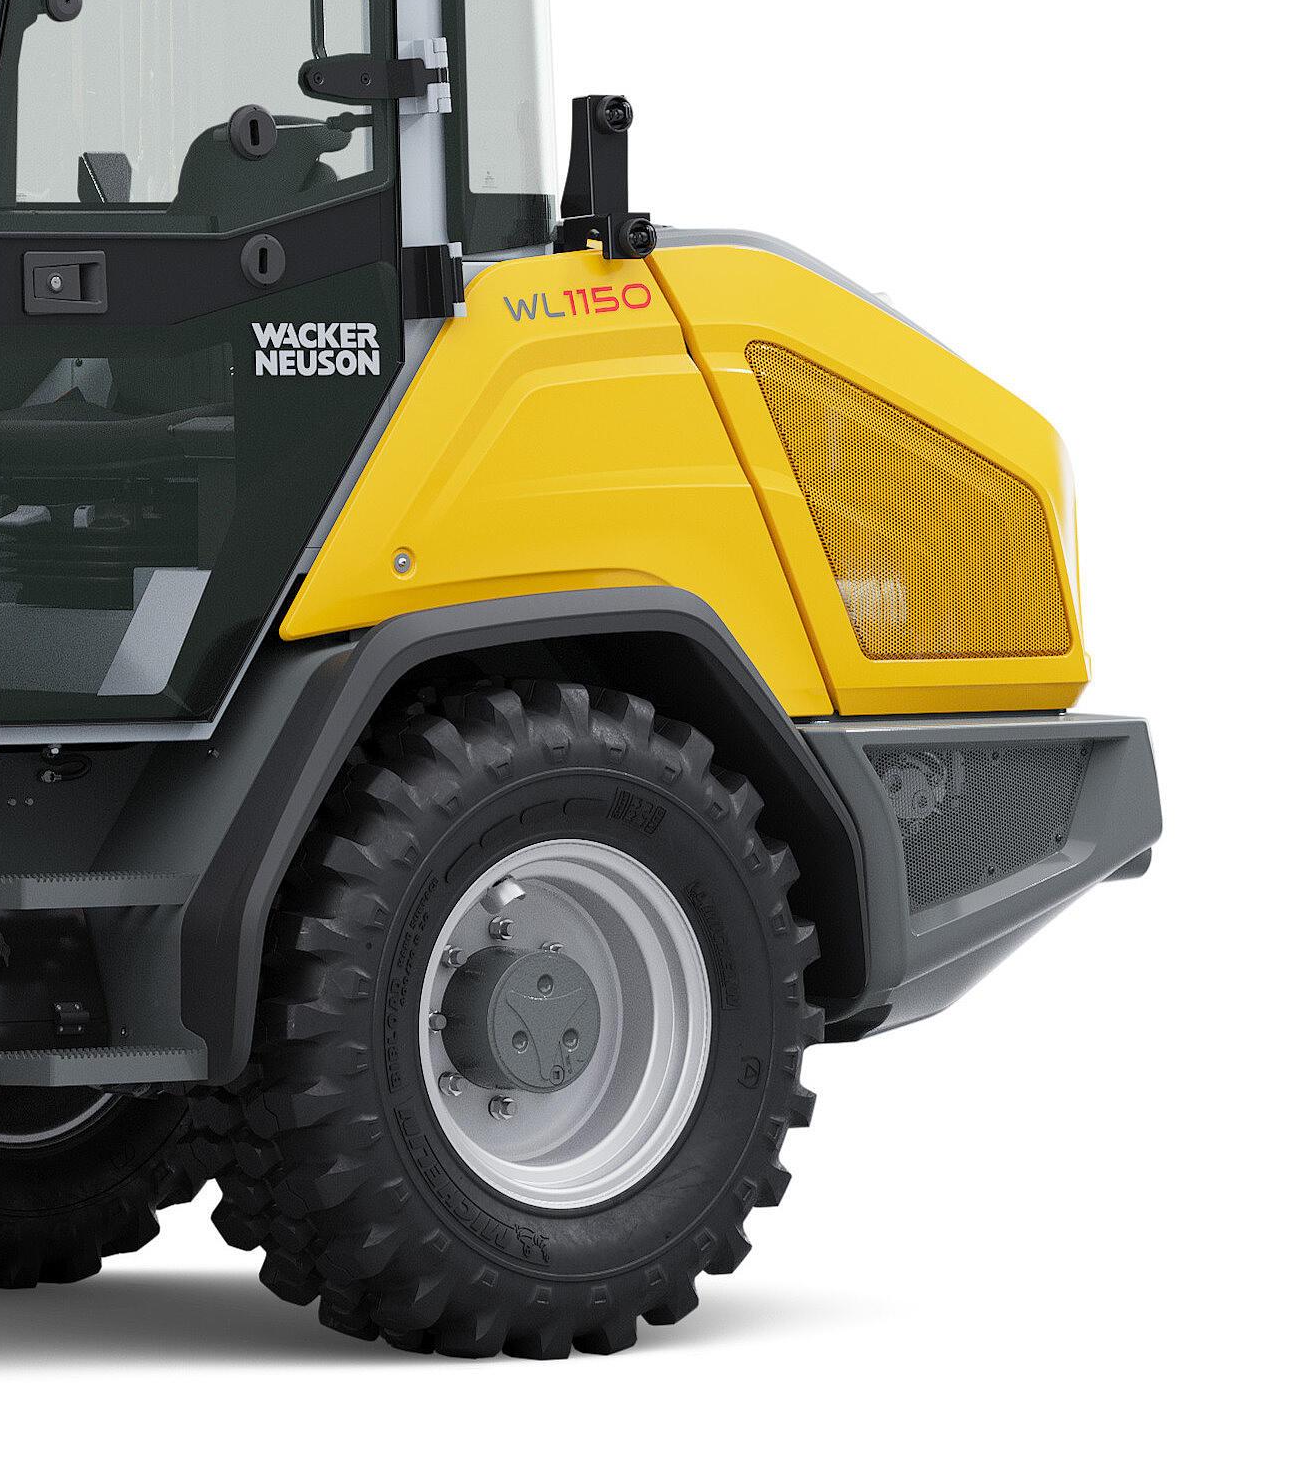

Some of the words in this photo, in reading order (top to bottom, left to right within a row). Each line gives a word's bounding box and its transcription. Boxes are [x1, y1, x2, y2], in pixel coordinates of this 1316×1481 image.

[504, 283, 652, 322] WL1150
[252, 322, 379, 349] WACKER
[255, 350, 380, 376] NEUSON
